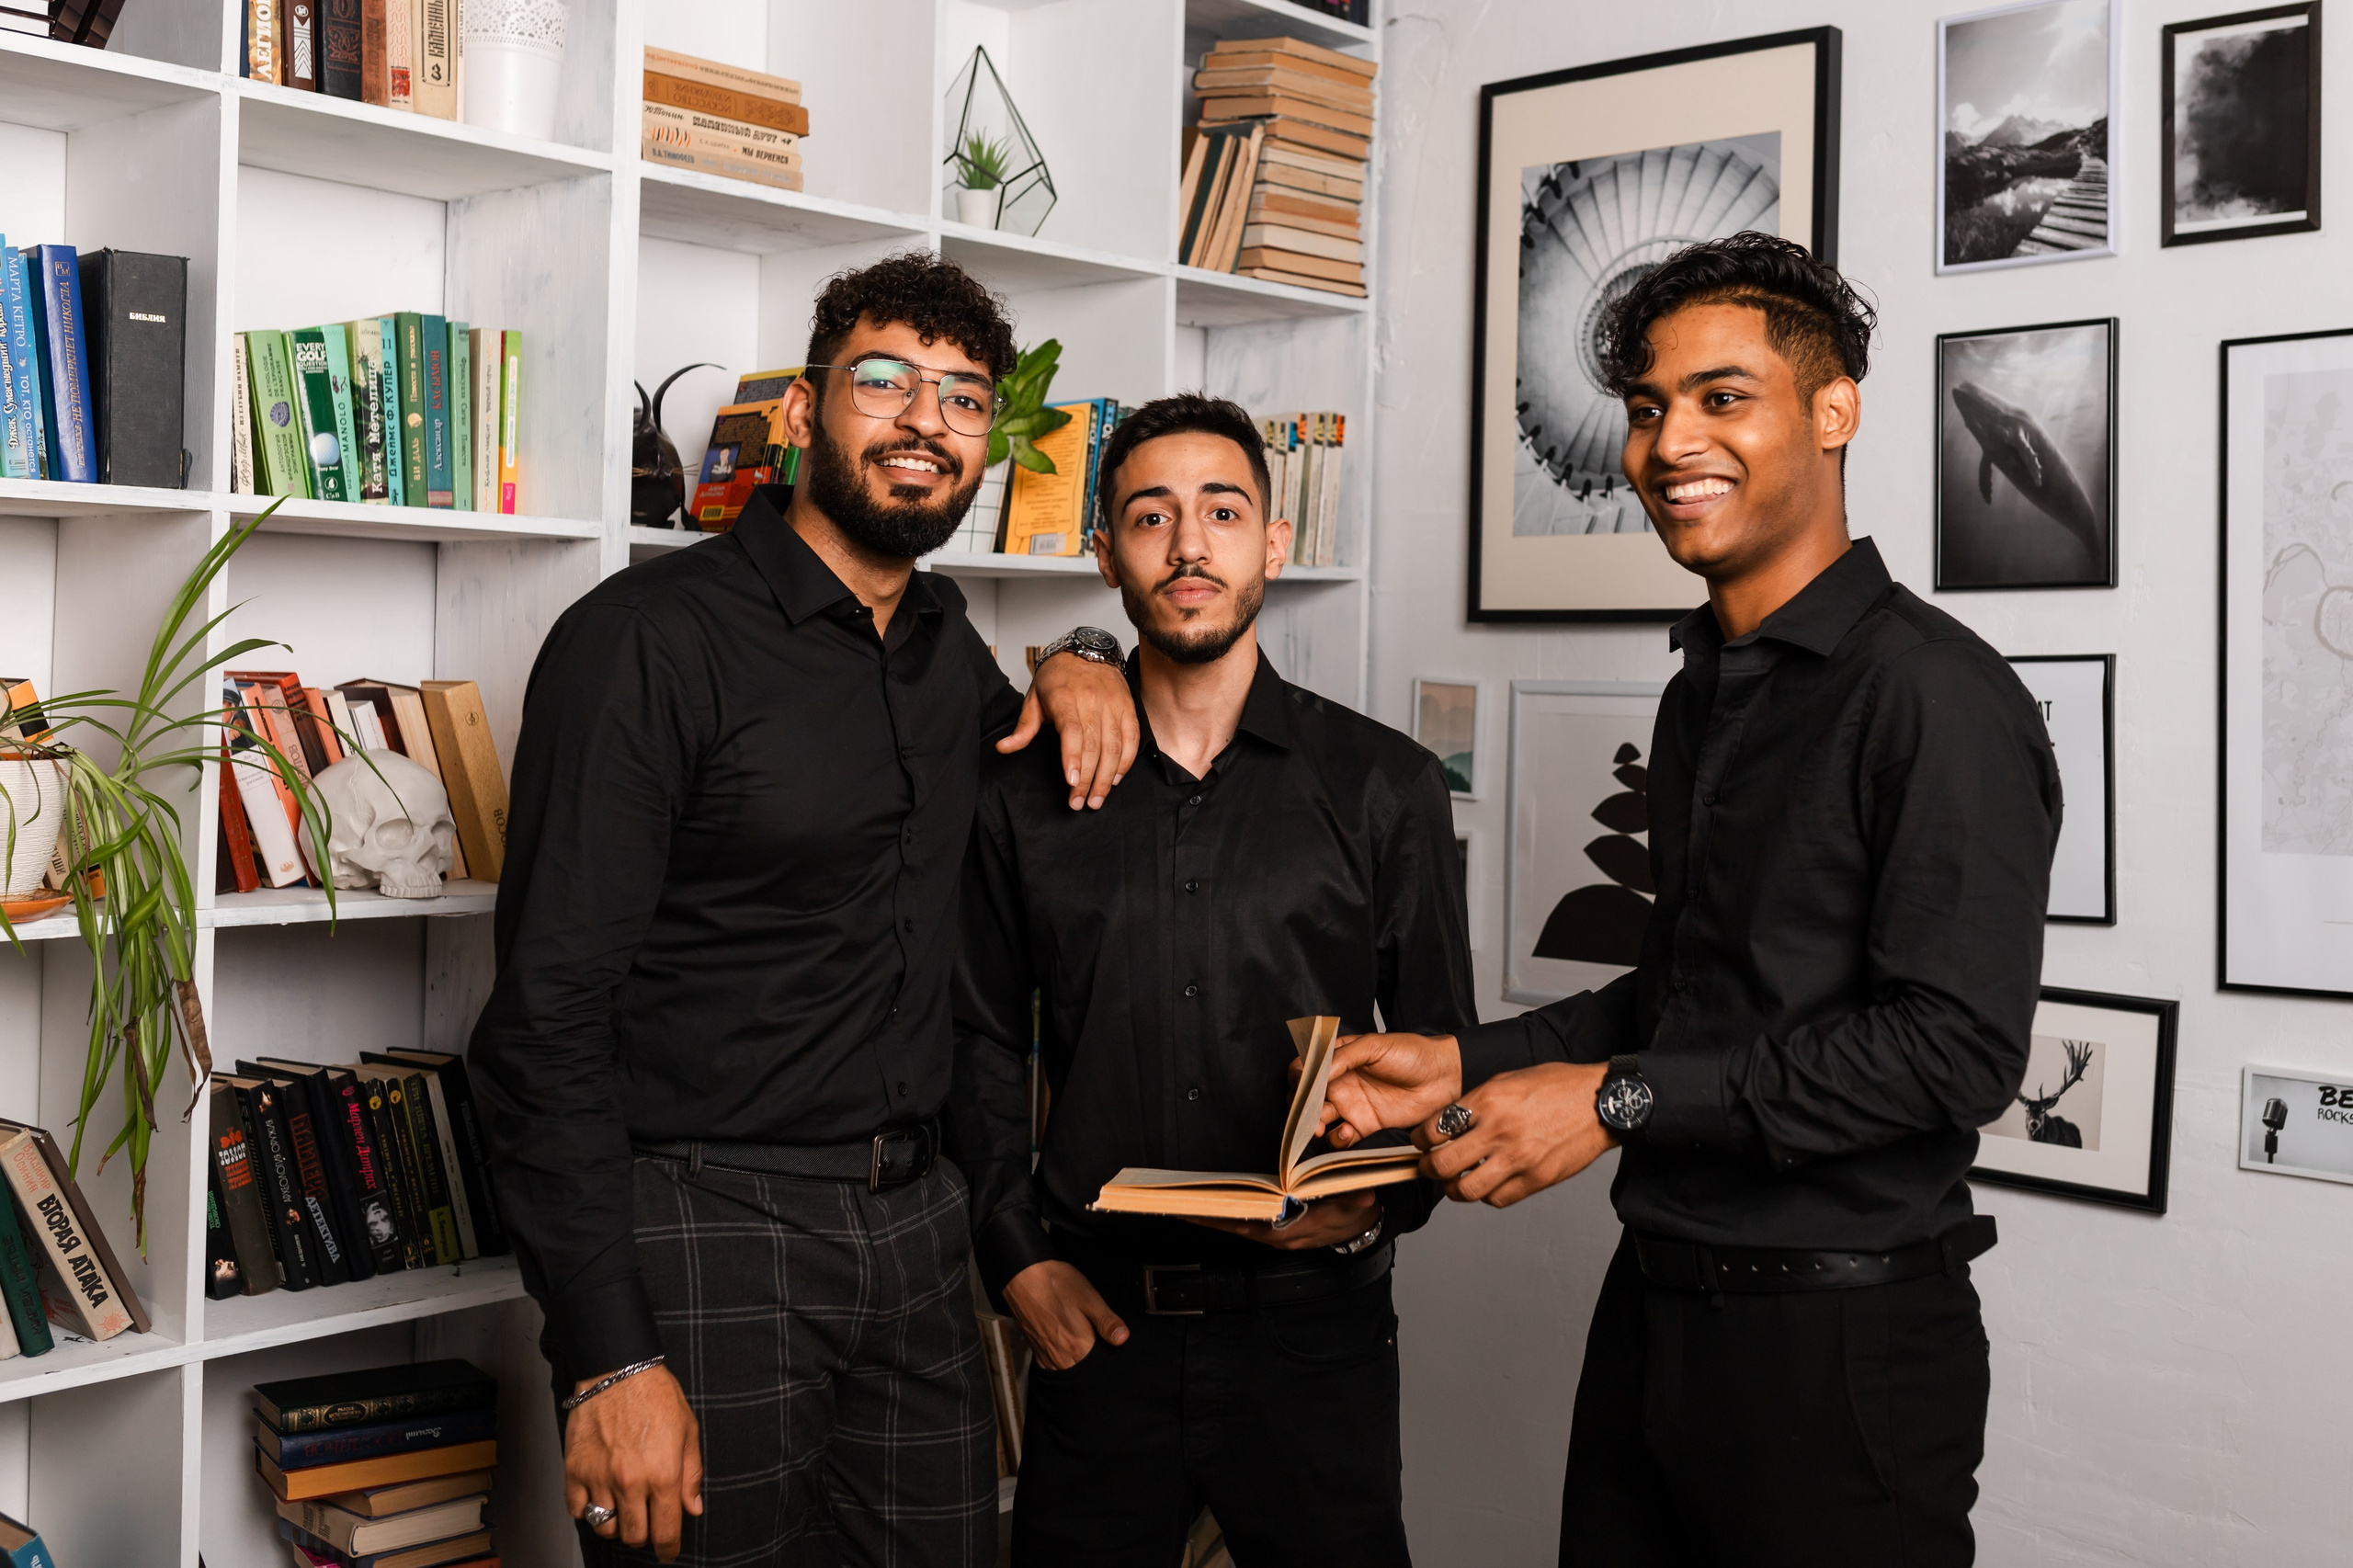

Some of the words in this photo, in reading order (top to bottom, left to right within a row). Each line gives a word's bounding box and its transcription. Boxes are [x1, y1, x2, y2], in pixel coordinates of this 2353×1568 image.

[7, 256, 22, 302] МАРТА
[13, 305, 27, 347] КЕТРО
[61, 280, 75, 340] НИКОГДА
[129, 312, 166, 324] БИБЛИЯ
[296, 342, 325, 352] EVERY
[296, 350, 326, 362] GOLF
[0, 341, 18, 415] Сумасшедший
[19, 374, 29, 396] ТОТ,
[65, 340, 80, 404] ПОМЕРКНЕТ
[263, 356, 273, 398] ANTHOLOGIE
[429, 350, 443, 410] КАСЫМОВ
[21, 400, 32, 421] КТО
[71, 403, 83, 423] НЕ
[367, 359, 383, 445] Метелица
[7, 415, 20, 450] Джек
[25, 424, 36, 472] останется
[337, 402, 350, 452] MANOLO
[434, 418, 444, 472] Александр
[275, 434, 285, 474] АНТОЛОГИЯ
[280, 433, 293, 481] ФРАНЦУЗСКОЙ
[287, 433, 300, 474] ЭПИГРАММЫ
[371, 451, 384, 494] Катя
[387, 424, 398, 478] Джеймс
[219, 1142, 247, 1166] ЮМОР
[265, 1118, 280, 1153] ОРУЖИЯ
[347, 1102, 363, 1147] Марлен
[356, 1145, 377, 1191] Дитрих
[13, 1152, 38, 1194] ОСИНИН
[22, 1142, 51, 1190] ВЛАДИМИР
[273, 1153, 293, 1204] АРХЕОЛОГИЯ
[36, 1192, 82, 1256] ВТОРАЯ
[67, 1253, 109, 1310] АТАКА
[305, 1196, 341, 1265] ДЕТЕКТИВА
[6, 1234, 28, 1284] МАТЬЕ
[18, 1288, 44, 1338] МИРЕЙ
[404, 1426, 442, 1440] Василий
